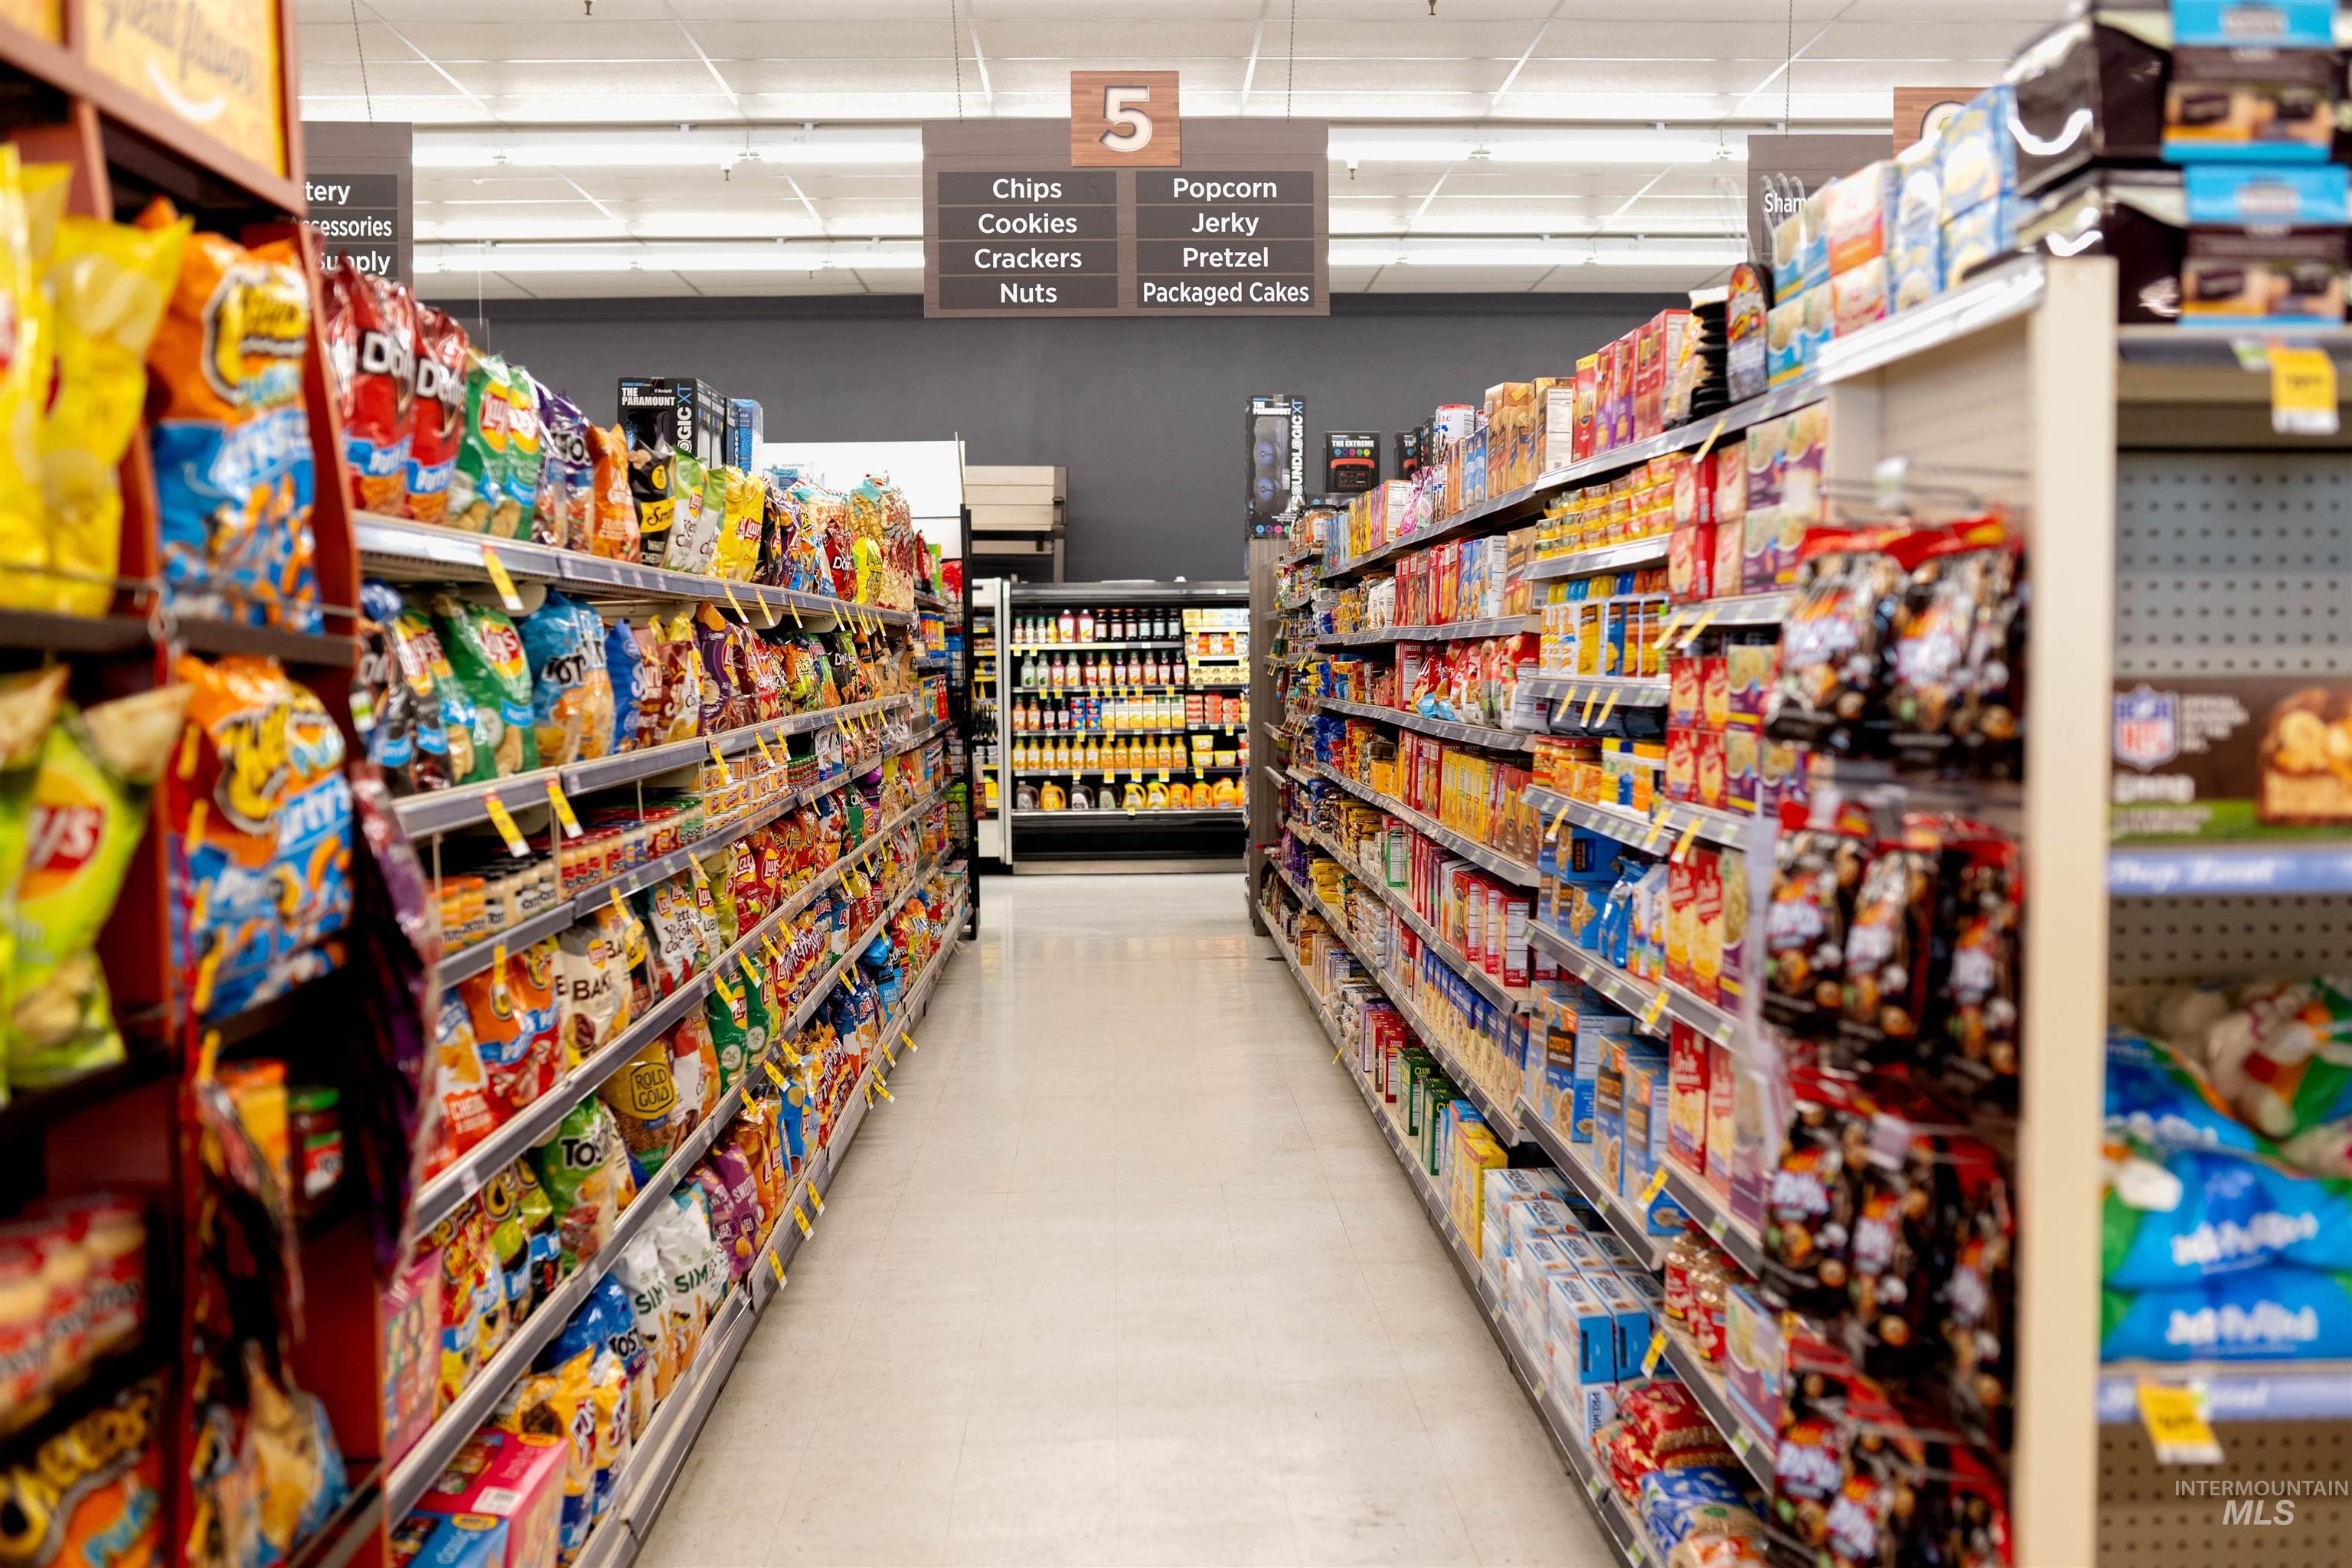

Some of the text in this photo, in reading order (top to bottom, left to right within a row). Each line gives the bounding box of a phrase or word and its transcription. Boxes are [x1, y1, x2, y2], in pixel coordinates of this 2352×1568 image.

[1098, 85, 1153, 152] 5
[302, 181, 351, 205] tery
[993, 178, 1061, 202] Chips
[1174, 178, 1276, 201] Popcorn
[1764, 193, 1807, 214] Sham
[978, 213, 1076, 234] Cookies
[1192, 213, 1259, 236] Jerky
[975, 248, 1081, 268] Crackers
[1184, 247, 1268, 267] Pretzel
[1001, 283, 1057, 302] Nuts
[1144, 282, 1308, 305] Packaged Cakes
[621, 397, 676, 407] PARAMOUNT
[622, 387, 639, 397] THE
[635, 1067, 668, 1091] ROLD
[1414, 1067, 1430, 1076] CLUB
[638, 1085, 671, 1108] GOLD
